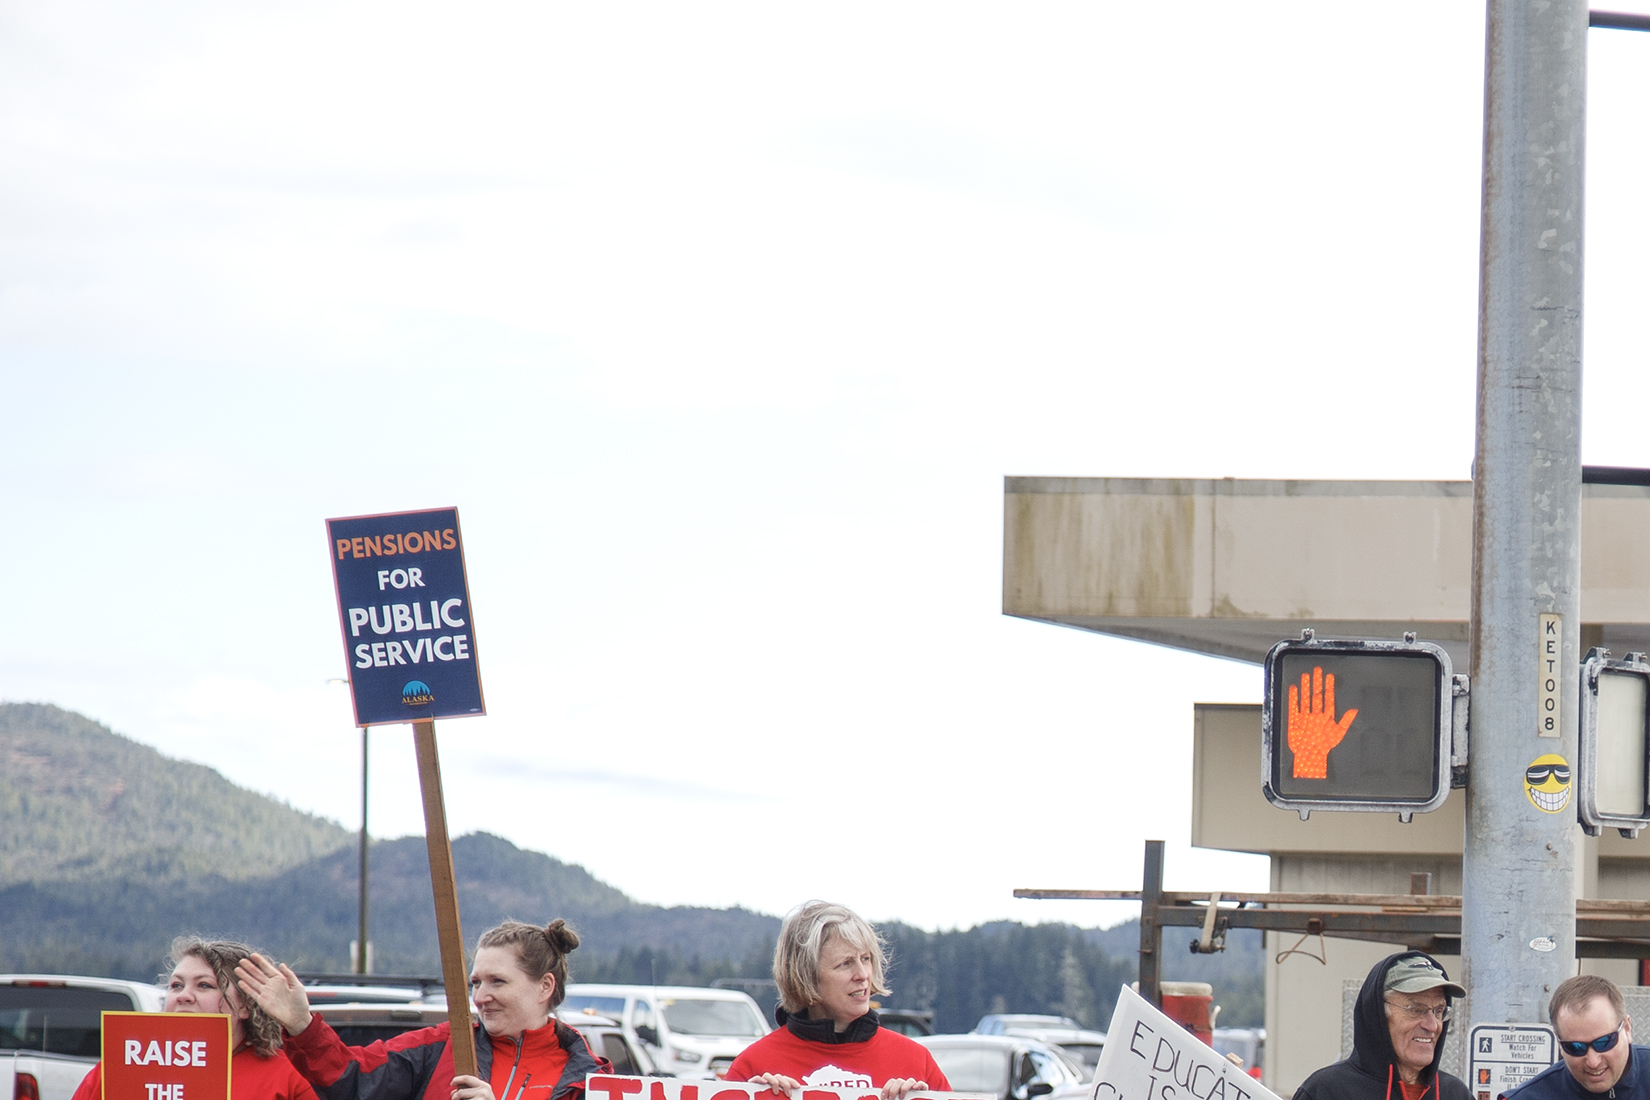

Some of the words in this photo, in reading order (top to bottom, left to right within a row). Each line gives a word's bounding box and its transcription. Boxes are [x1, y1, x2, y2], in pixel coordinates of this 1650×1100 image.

[336, 528, 457, 560] PENSIONS
[377, 567, 426, 591] FOR
[348, 598, 465, 637] PUBLIC
[355, 634, 470, 669] SERVICE
[1518, 1035, 1546, 1043] CROSSING
[124, 1040, 207, 1067] RAISE
[1511, 1052, 1534, 1060] Vehicles
